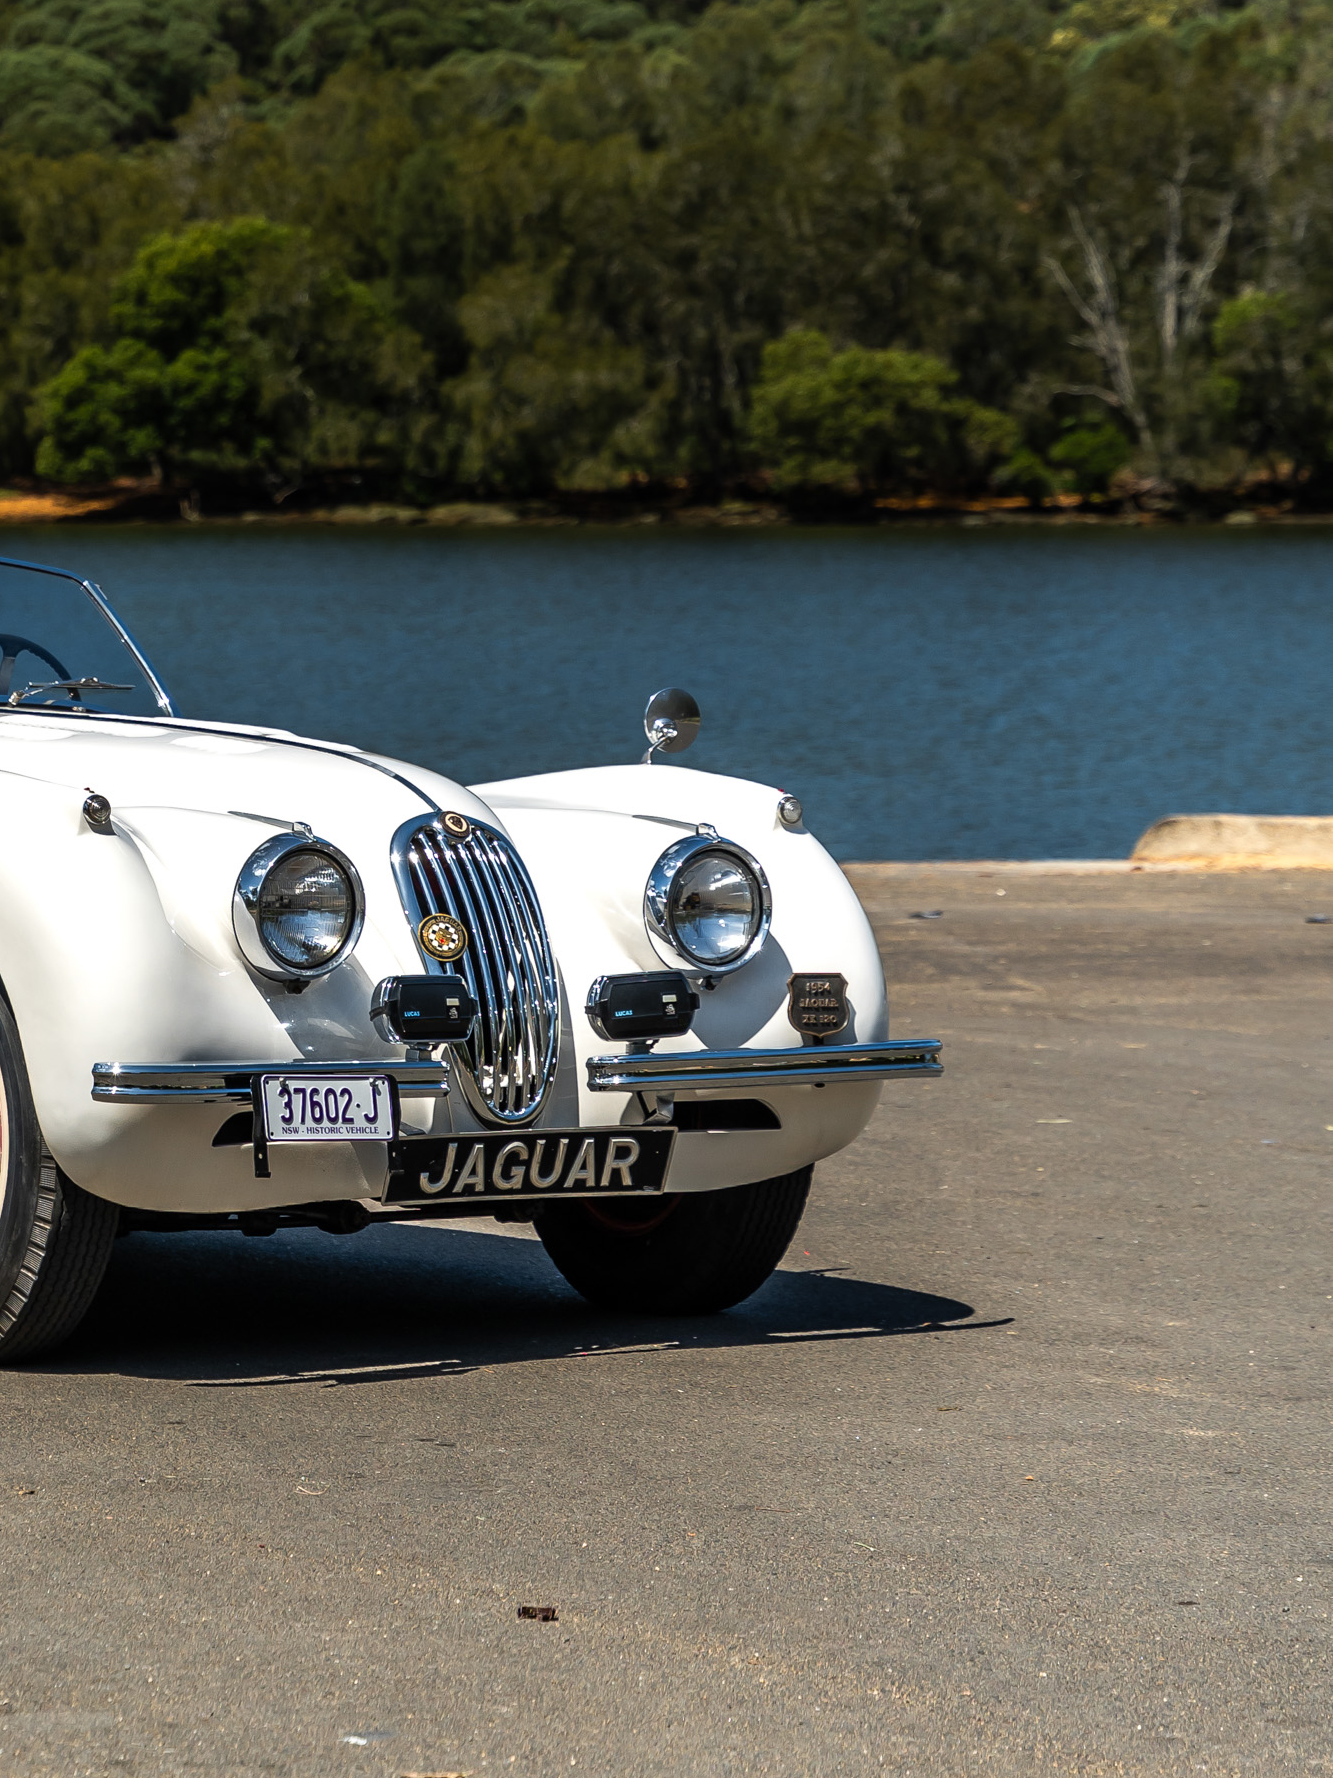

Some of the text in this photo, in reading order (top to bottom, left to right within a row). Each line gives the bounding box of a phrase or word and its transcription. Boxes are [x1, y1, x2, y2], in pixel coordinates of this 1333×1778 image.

[806, 982, 830, 993] 1954
[615, 1009, 633, 1017] LUCAS
[819, 1014, 837, 1023] 120
[281, 1126, 300, 1135] NSW
[306, 1126, 344, 1135] HISTORIC
[345, 1126, 379, 1135] VEHICLE
[420, 1137, 640, 1194] JAGUAR
